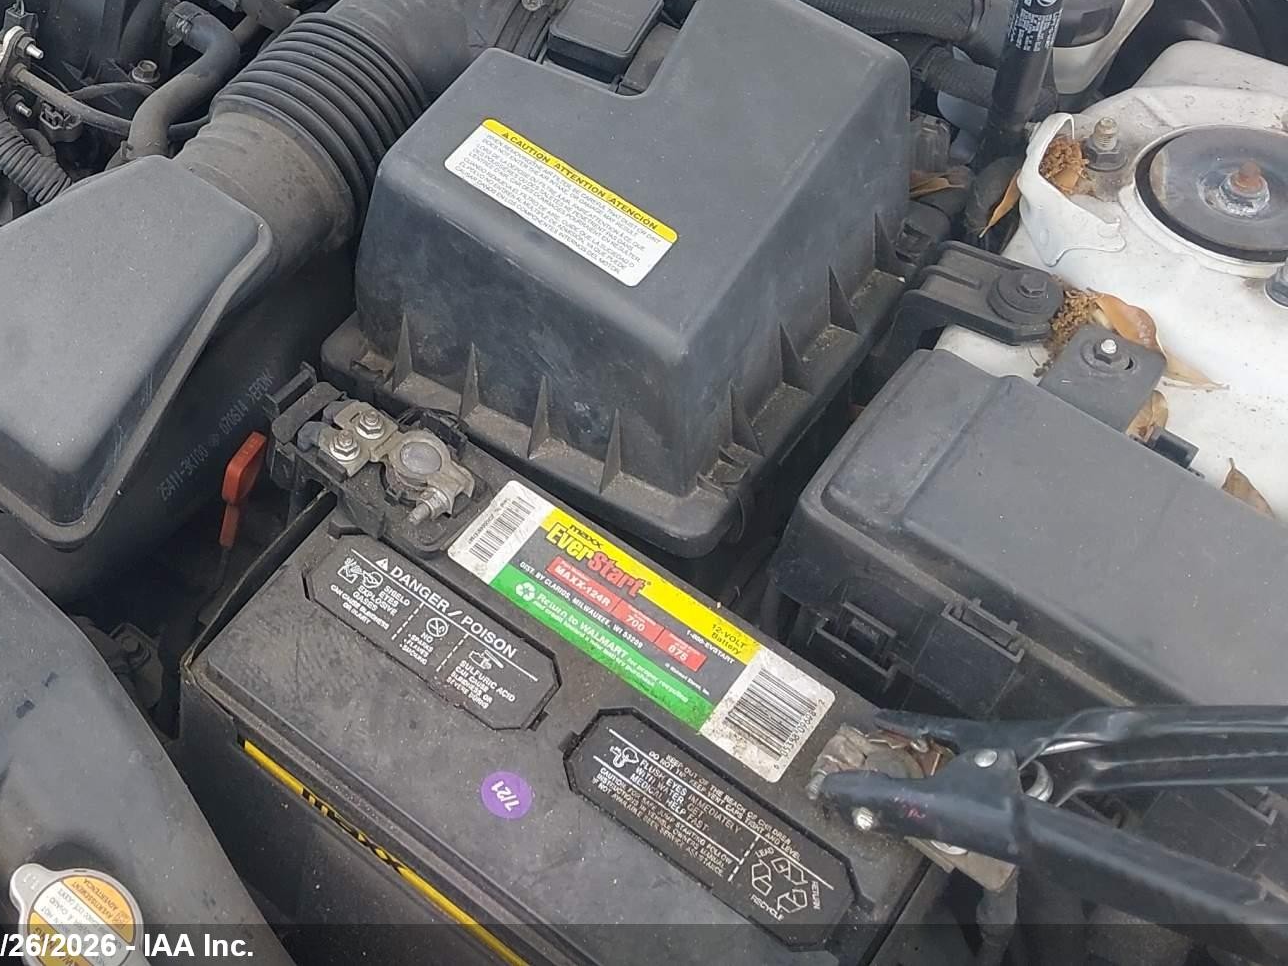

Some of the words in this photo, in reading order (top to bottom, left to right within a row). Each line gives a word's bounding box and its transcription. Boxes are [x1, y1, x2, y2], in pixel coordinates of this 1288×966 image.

[508, 135, 551, 164] CAUTION
[552, 162, 607, 198] ATTENTION
[606, 195, 660, 231] ATENCIÓN
[568, 523, 603, 549] maxx
[534, 571, 545, 581] BY
[542, 521, 649, 599] EverStart
[356, 584, 398, 617] EXPLOSIVE
[552, 564, 612, 608] MAXX-124R
[389, 564, 451, 613] DANGER
[459, 613, 518, 659] POISON
[623, 614, 646, 632] 700
[419, 630, 434, 644] NO
[577, 621, 629, 660] WALMART
[709, 631, 742, 656] Battery
[710, 622, 747, 650] 12-VOLT
[458, 659, 498, 690] SULFURIC
[495, 685, 516, 703] ACID
[490, 779, 520, 812] 7/21
[628, 772, 664, 802] MEDICAL
[664, 797, 687, 817] HELP
[638, 757, 667, 782] FLUSH
[664, 776, 688, 797] EYES
[686, 791, 741, 835] IMMEDIATELY
[748, 892, 785, 922] RECYCLE
